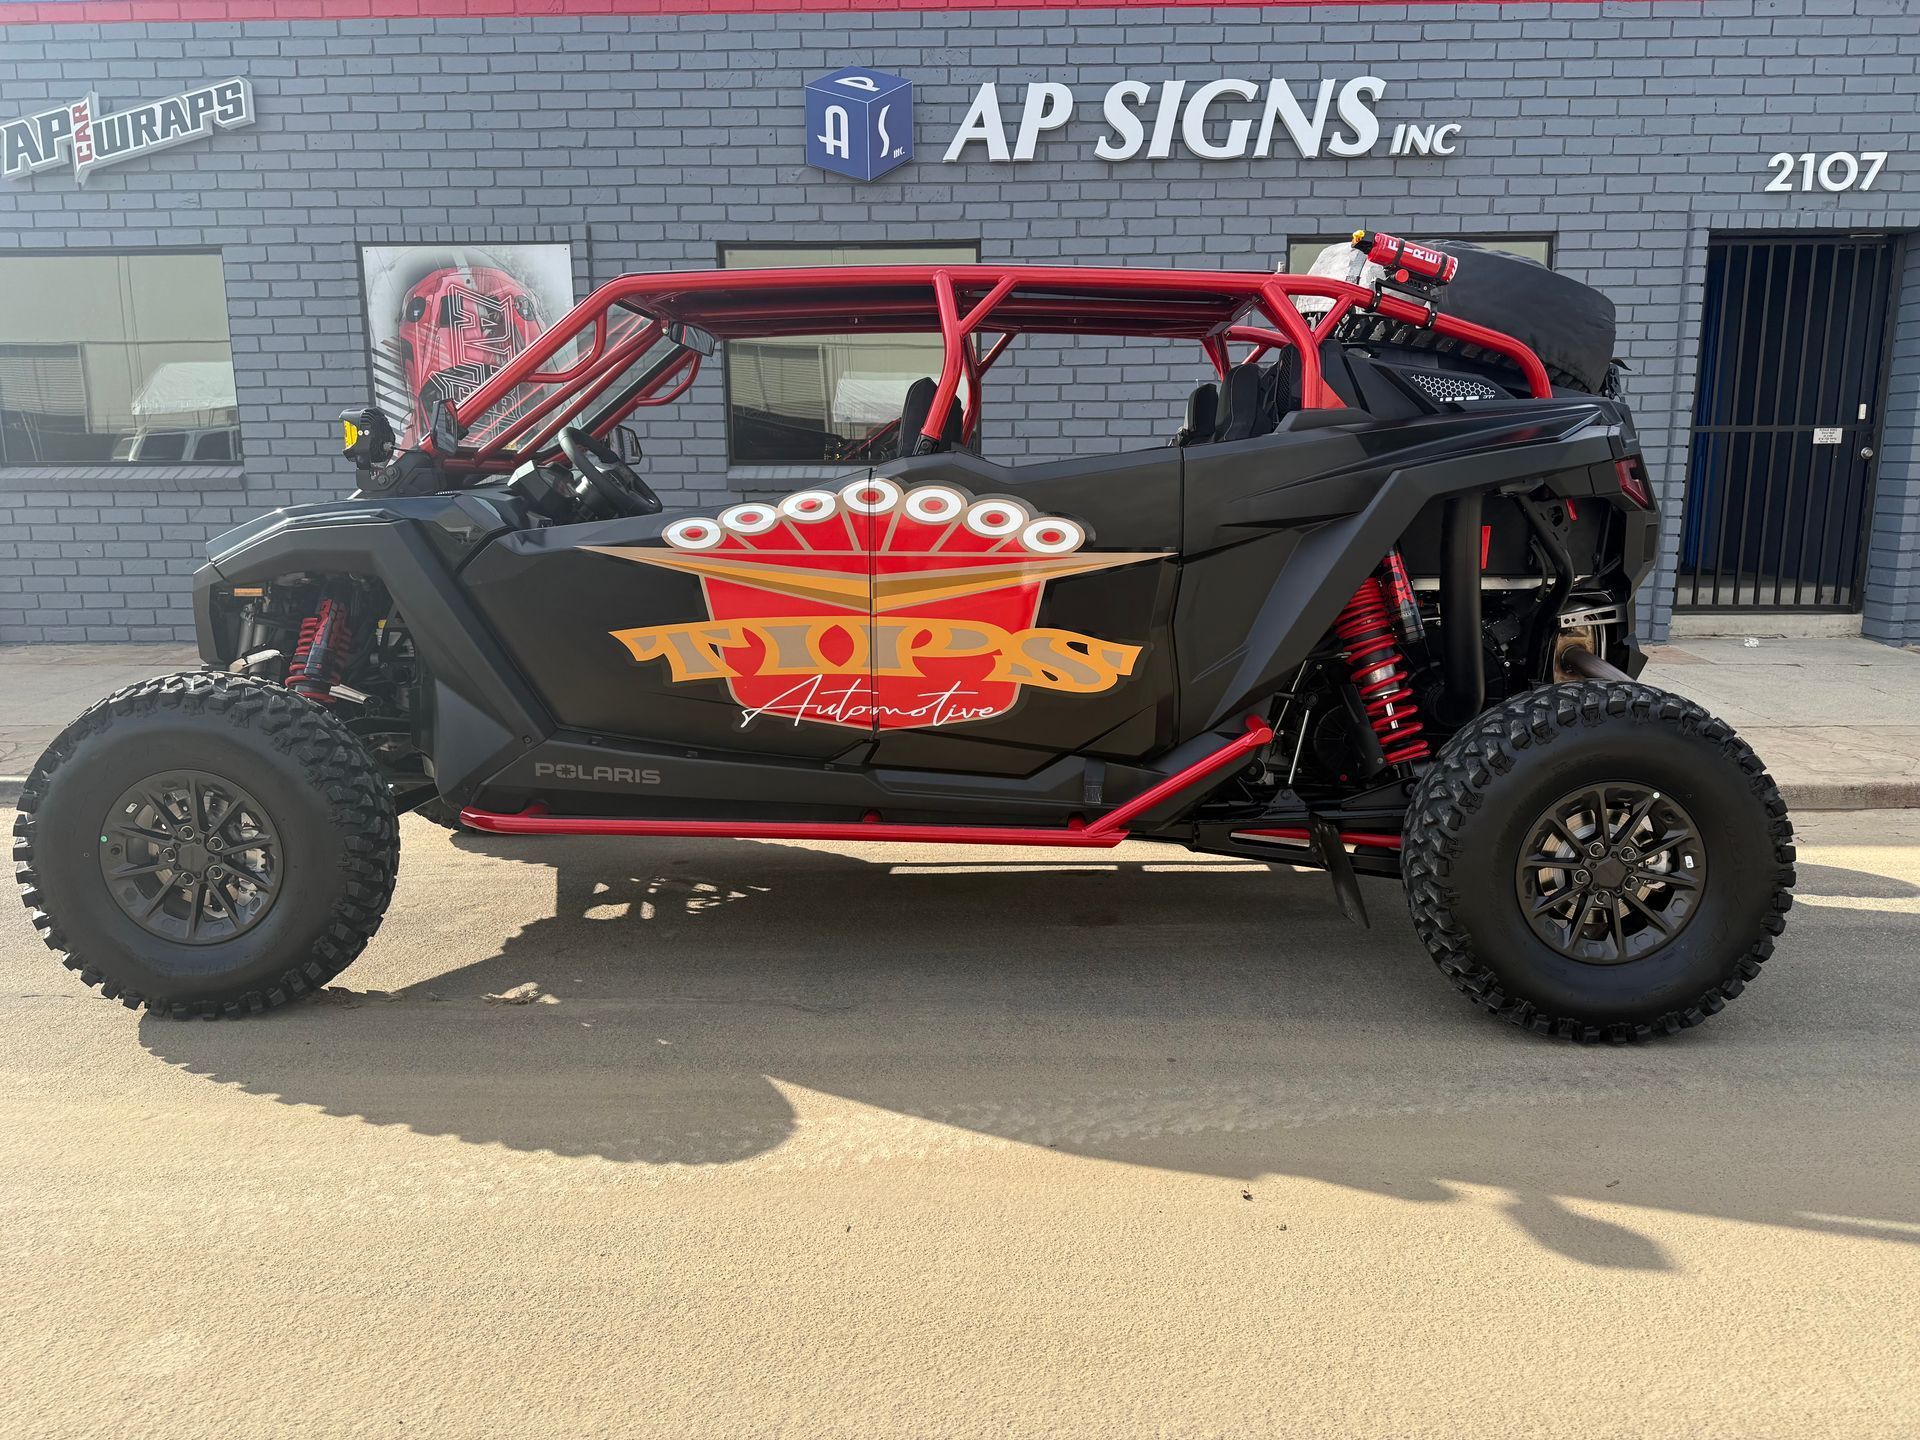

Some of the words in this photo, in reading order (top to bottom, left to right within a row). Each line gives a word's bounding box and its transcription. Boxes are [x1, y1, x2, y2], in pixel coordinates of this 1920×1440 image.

[3, 108, 73, 172] AP
[72, 100, 94, 165] CAR
[92, 81, 245, 157] WRAPS
[943, 81, 1074, 162] AP
[1093, 76, 1387, 161] SIGNS
[1389, 123, 1462, 156] INC
[1764, 151, 1888, 192] 2107
[1387, 238, 1438, 264] FIRE
[608, 615, 1143, 693] TIPS
[740, 674, 1003, 728] Automotive
[534, 762, 661, 784] POLARIS
